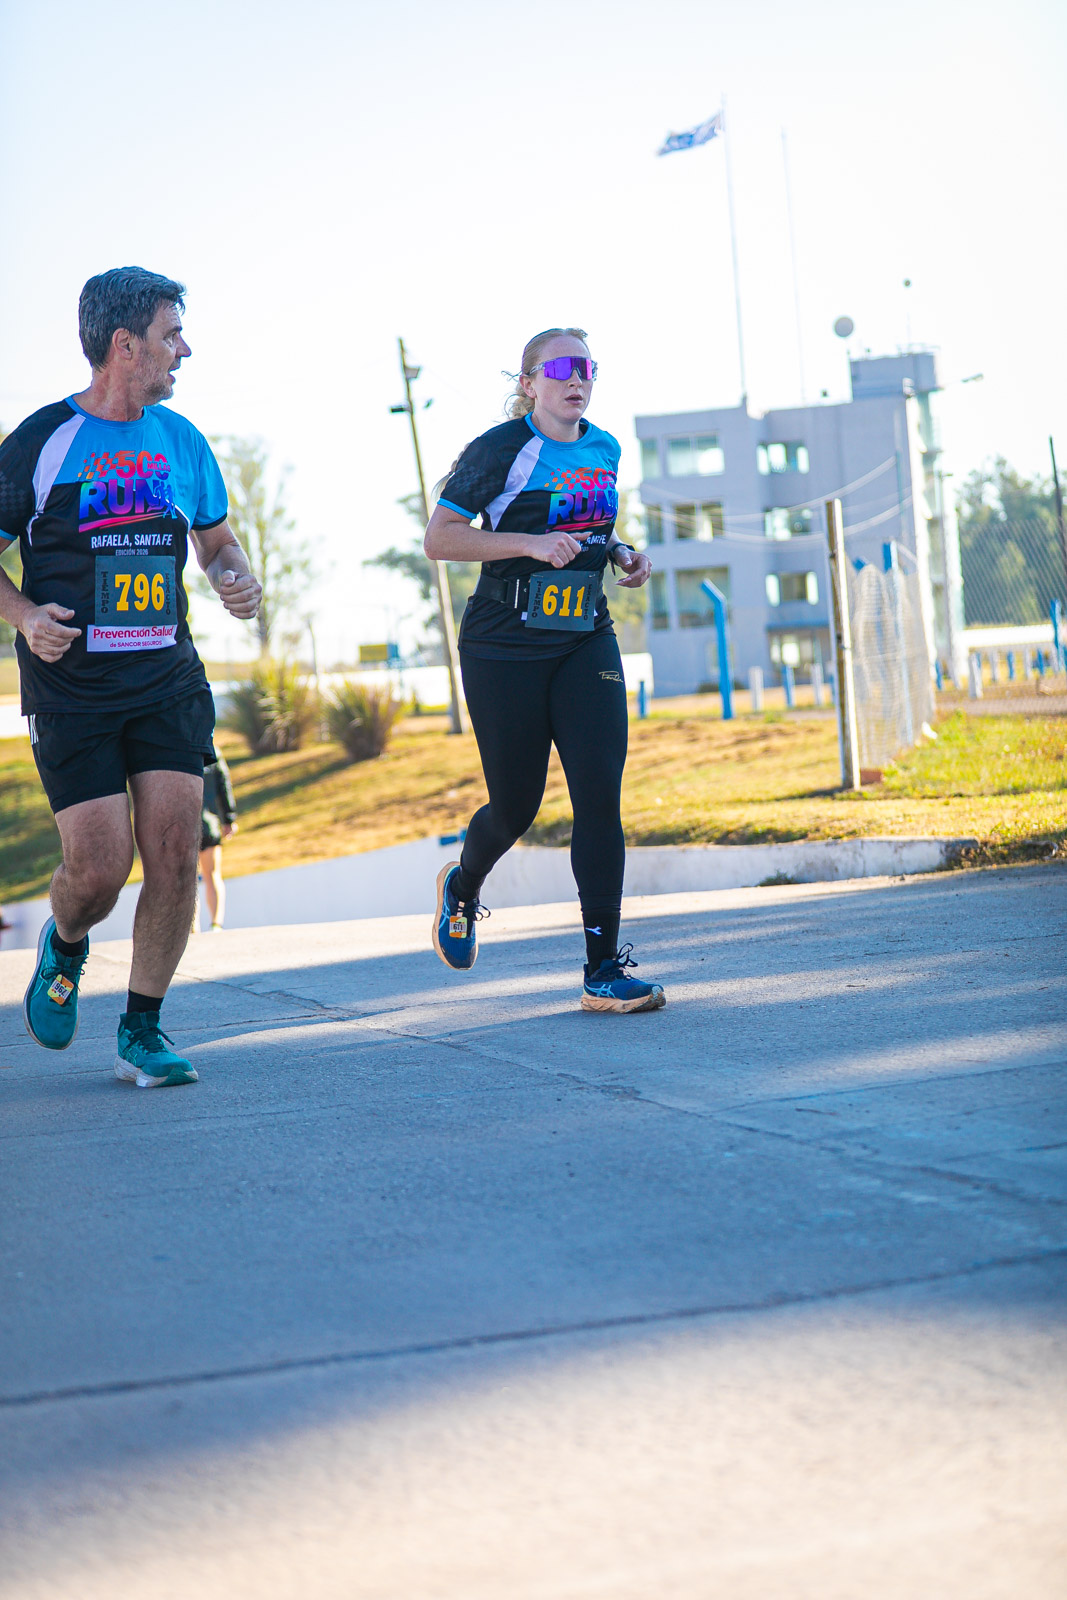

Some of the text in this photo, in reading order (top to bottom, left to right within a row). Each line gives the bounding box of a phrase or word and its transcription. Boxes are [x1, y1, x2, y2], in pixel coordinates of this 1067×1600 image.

[147, 462, 171, 472] MILLAS
[79, 479, 161, 519] RUN
[547, 491, 614, 525] RUN
[91, 533, 173, 549] RAFAELA, SANTA FE
[101, 571, 109, 614] TIEMPO
[114, 573, 165, 611] 796
[542, 584, 585, 617] 611
[93, 625, 175, 639] Prevención Salud
